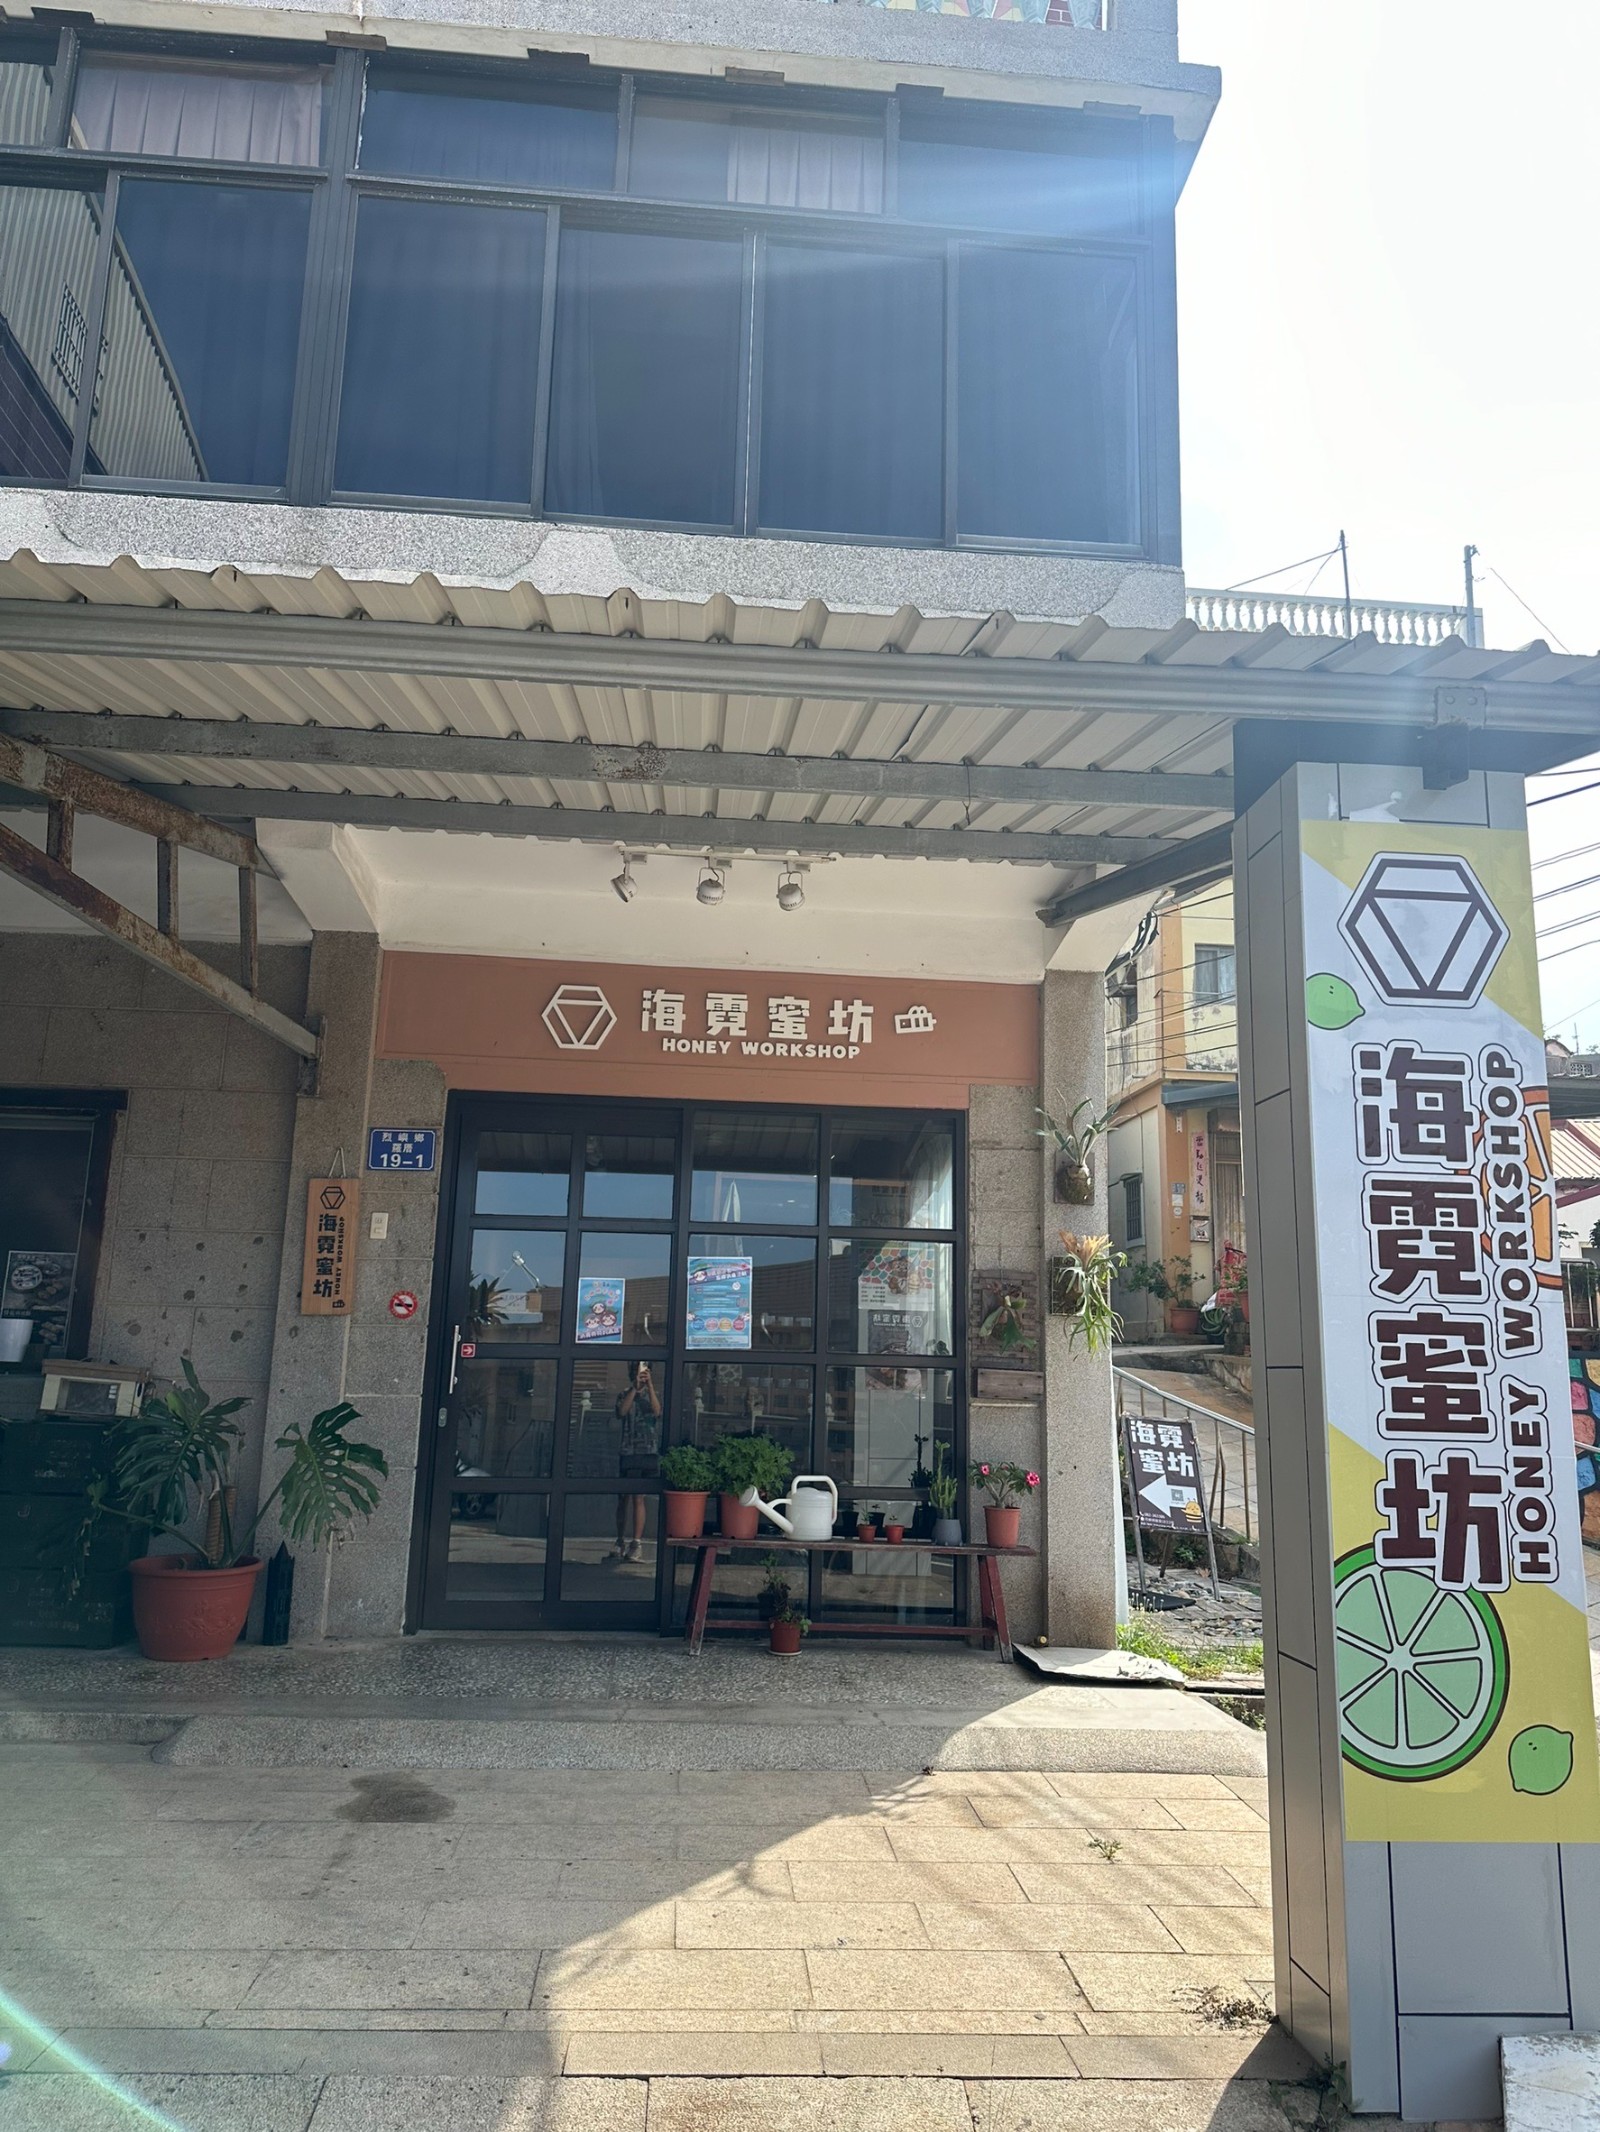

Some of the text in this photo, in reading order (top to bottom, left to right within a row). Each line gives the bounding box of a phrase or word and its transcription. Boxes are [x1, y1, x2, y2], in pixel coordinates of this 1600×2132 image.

[642, 989, 873, 1043] 海霓蜜坊
[662, 1038, 861, 1059] HONEY WORKSHOP
[381, 1132, 425, 1142] 烈嶼鄉
[380, 1153, 424, 1168] 19-1
[312, 1213, 338, 1298] 海霓蜜坊
[334, 1216, 345, 1295] HONEY WORKSHOP
[1359, 1047, 1503, 1584] 海霓蜜坊
[1486, 1050, 1551, 1574] HONEY WORKSHOP
[1130, 1420, 1185, 1449] 海霓
[1138, 1449, 1195, 1477] 蜜坊
